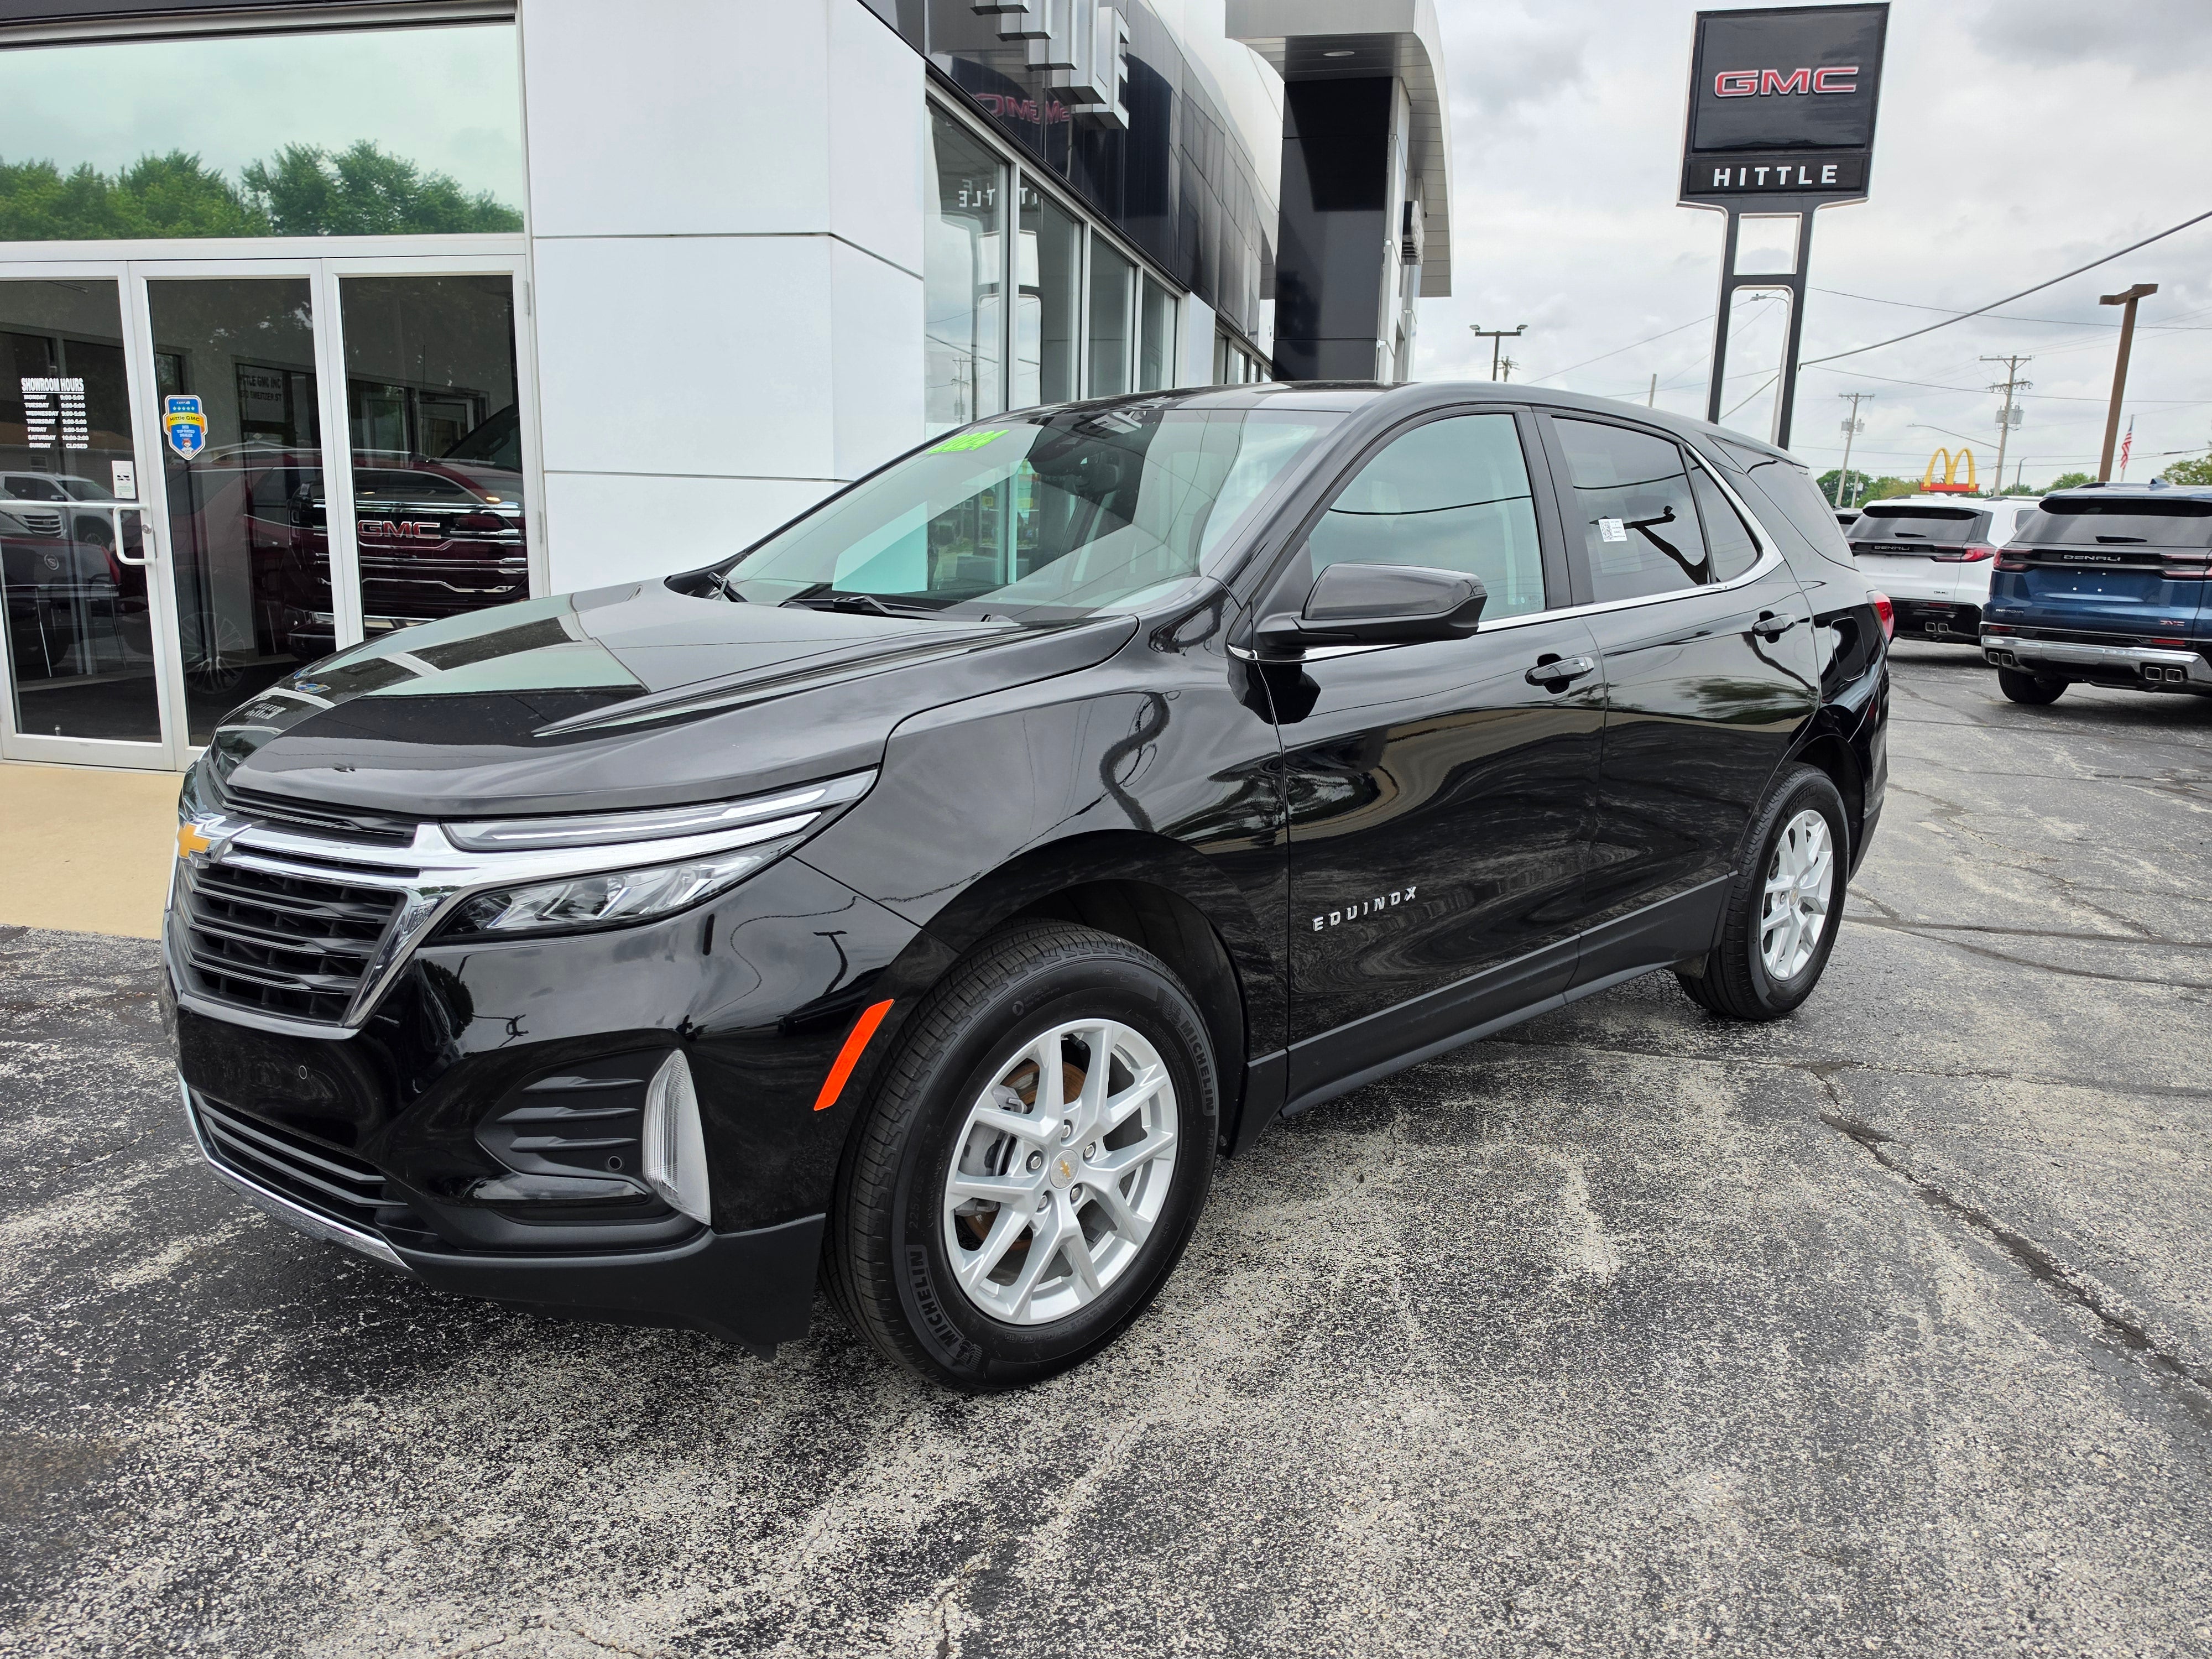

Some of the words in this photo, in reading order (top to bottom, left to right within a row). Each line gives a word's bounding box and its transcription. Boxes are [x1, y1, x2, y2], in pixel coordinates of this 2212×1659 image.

[1715, 66, 1859, 97] GMC
[1713, 164, 1839, 187] HITTLE
[21, 378, 60, 392] SHOWROOM
[60, 378, 85, 392] HOURS
[358, 520, 441, 539] GMC
[1312, 886, 1417, 932] EQUINOX
[1180, 1019, 1214, 1111] MICHELIN
[909, 1250, 959, 1348] MICHELIN
